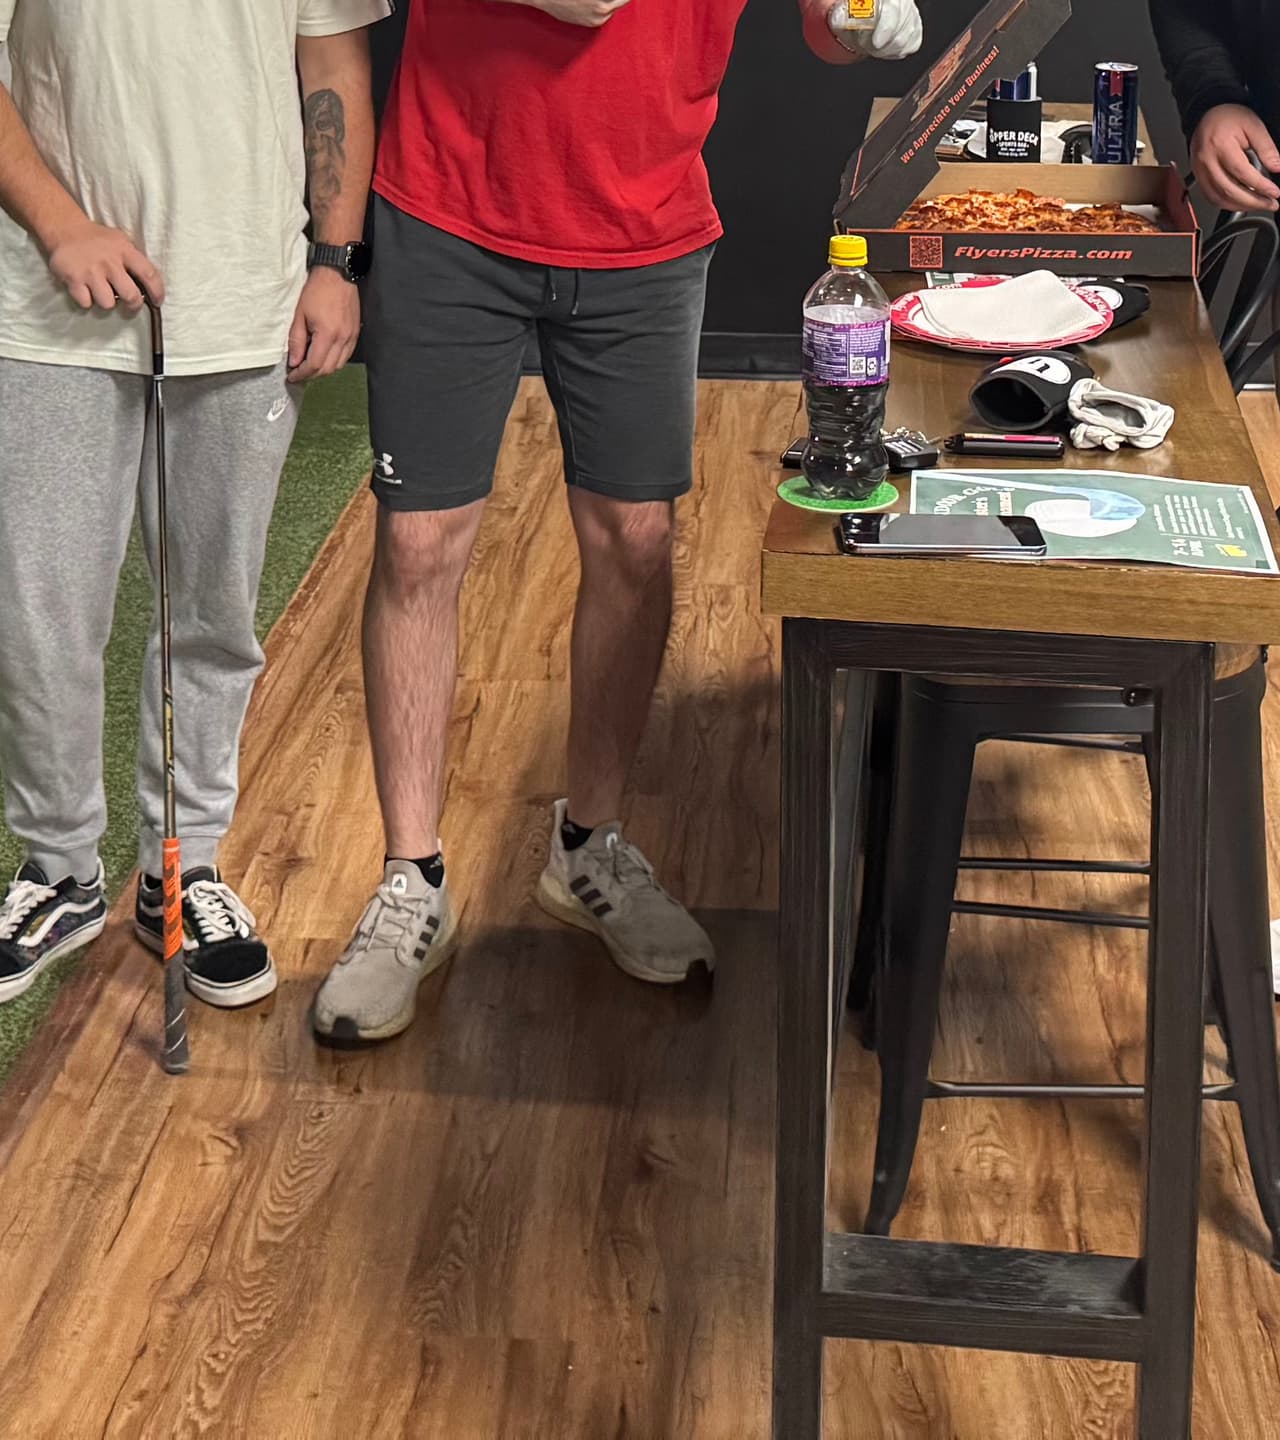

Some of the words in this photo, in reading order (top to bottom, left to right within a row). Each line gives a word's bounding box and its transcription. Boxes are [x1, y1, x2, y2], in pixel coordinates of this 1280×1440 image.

[900, 147, 915, 164] We
[912, 105, 951, 151] Appreciate
[948, 84, 968, 107] Your
[965, 44, 1000, 87] Business!
[1107, 101, 1124, 163] ULTRA
[954, 245, 1133, 260] FlyersPizza.com
